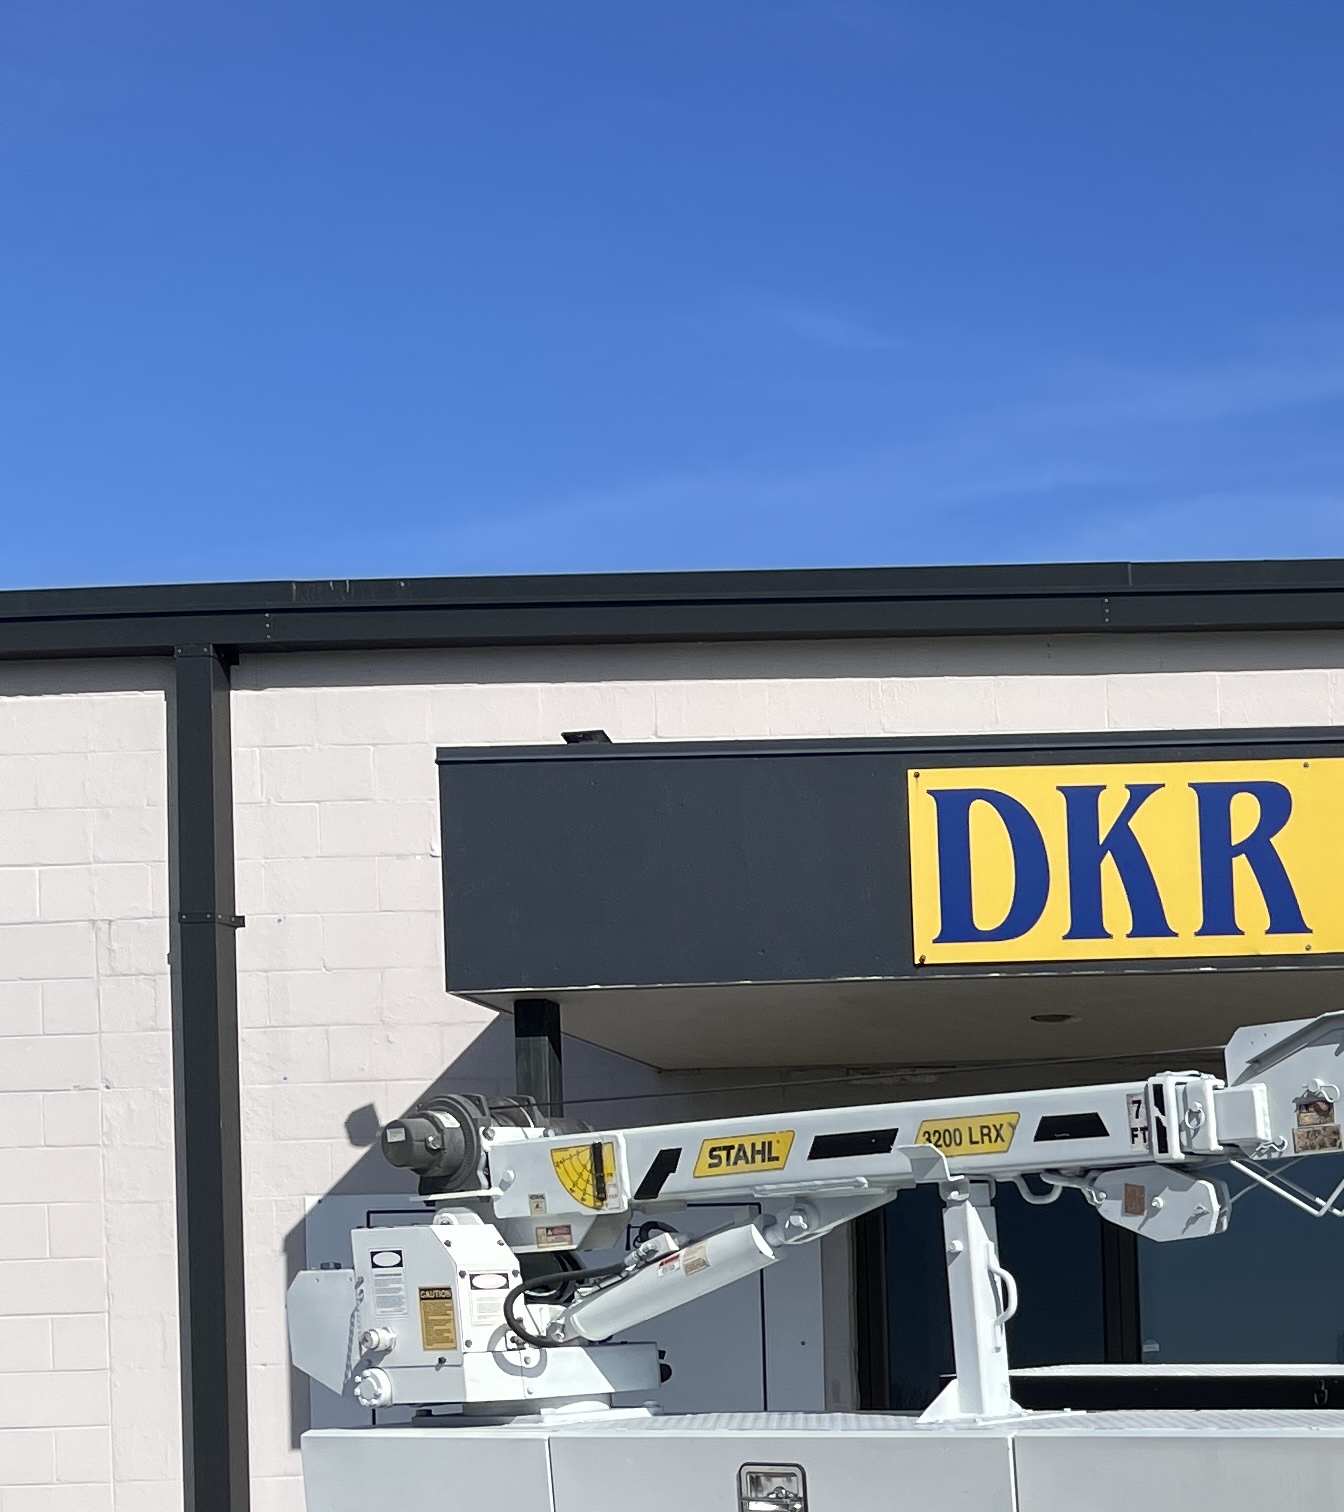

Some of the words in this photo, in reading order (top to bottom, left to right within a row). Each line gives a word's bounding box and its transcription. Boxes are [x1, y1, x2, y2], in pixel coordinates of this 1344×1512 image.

[930, 780, 1312, 944] DKR
[1131, 1099, 1142, 1119] 7
[922, 1127, 963, 1149] 3200
[968, 1123, 1006, 1146] LRX
[1130, 1127, 1149, 1145] FT
[707, 1140, 780, 1169] STAHL
